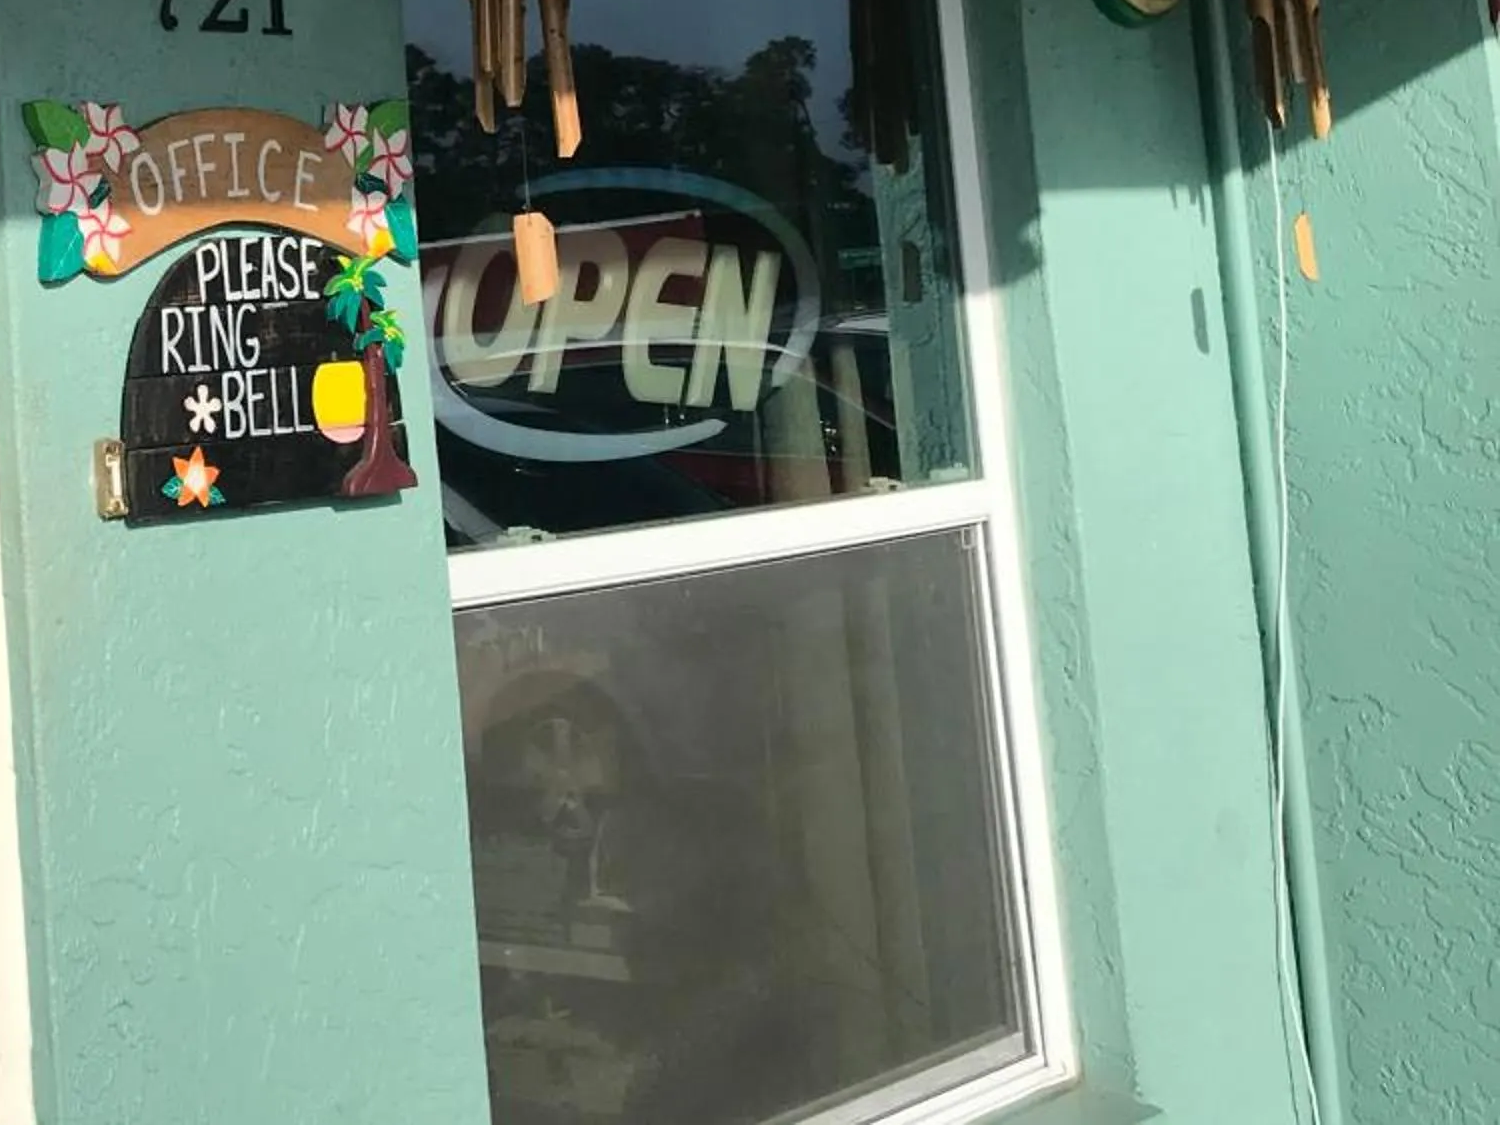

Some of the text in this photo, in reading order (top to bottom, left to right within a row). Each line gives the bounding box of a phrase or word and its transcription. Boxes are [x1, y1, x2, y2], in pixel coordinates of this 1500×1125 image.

[129, 132, 323, 217] OFFICE
[195, 236, 324, 305] PLEASE
[161, 305, 261, 374] RING
[442, 227, 783, 413] OPEN
[221, 366, 315, 440] BELL
